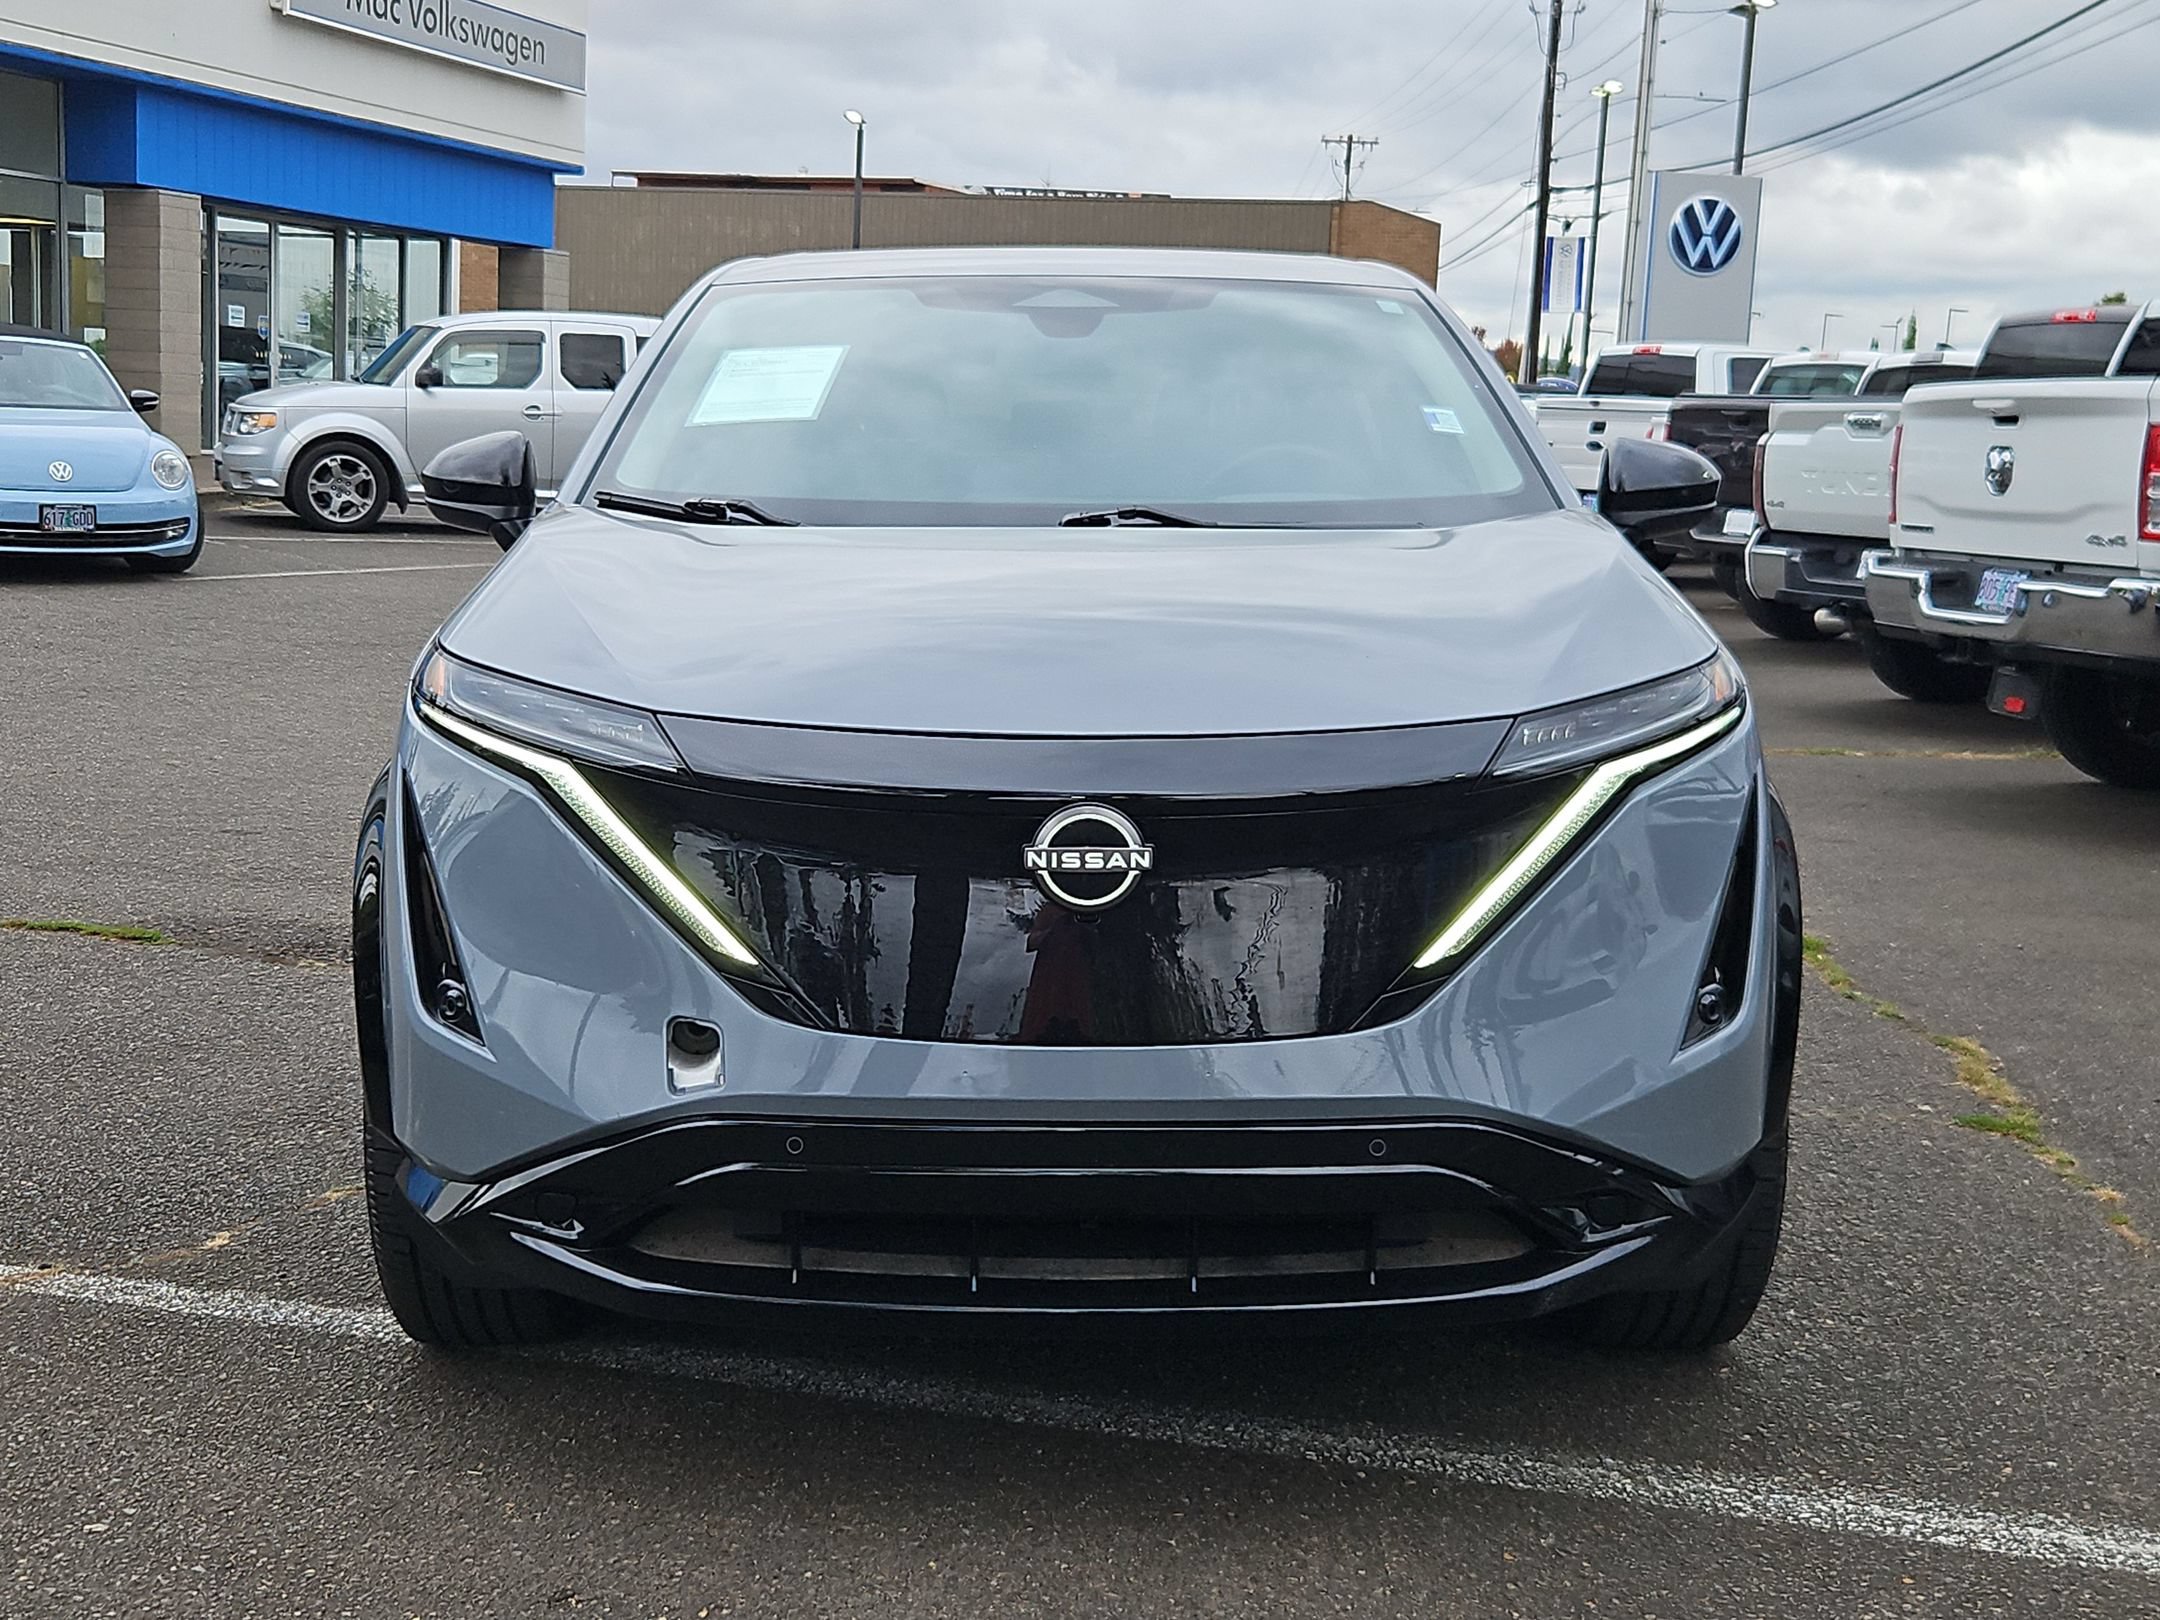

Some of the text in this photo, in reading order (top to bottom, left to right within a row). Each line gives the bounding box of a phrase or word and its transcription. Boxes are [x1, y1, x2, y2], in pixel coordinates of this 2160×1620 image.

[410, 0, 546, 66] Volkswagen
[1670, 196, 1741, 274] VW
[49, 461, 73, 481] VW
[43, 511, 65, 527] 617
[1027, 851, 1150, 869] NISSAN
